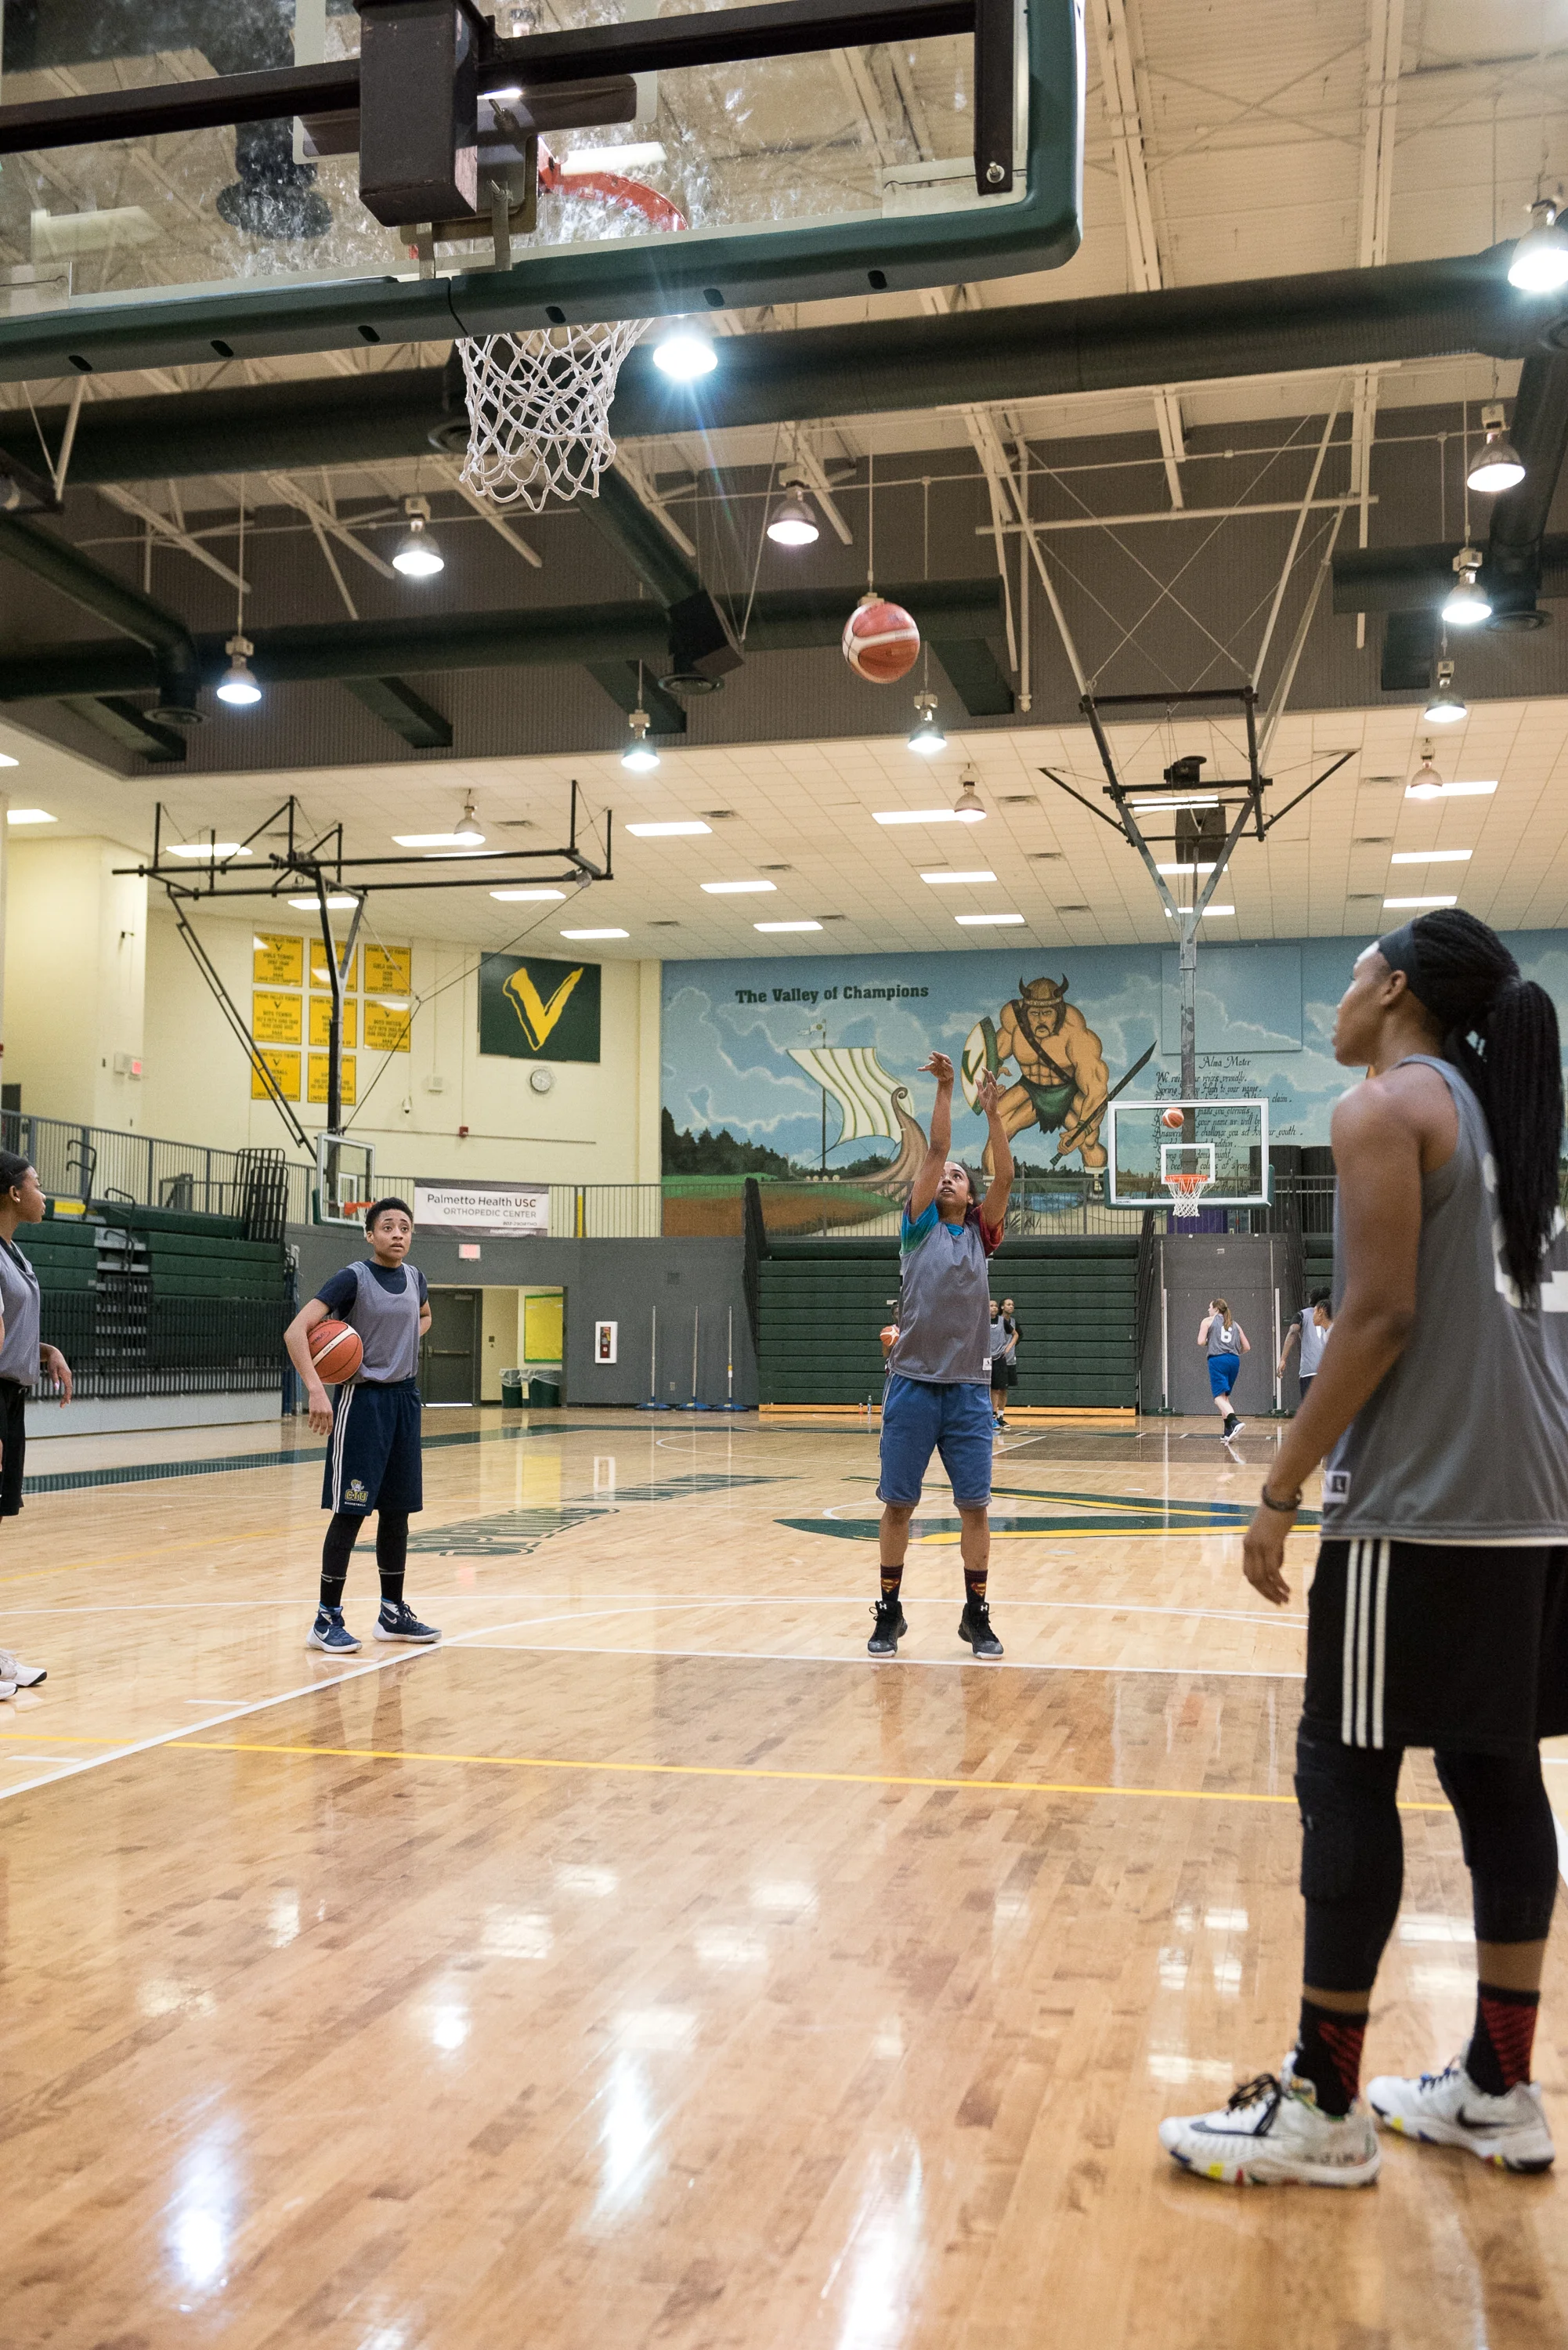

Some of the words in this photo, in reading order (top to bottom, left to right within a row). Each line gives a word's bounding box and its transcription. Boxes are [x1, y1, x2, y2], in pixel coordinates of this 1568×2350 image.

[735, 989, 768, 1003] The
[771, 988, 819, 1004] Valley
[823, 986, 838, 1000] of
[843, 985, 930, 1001] Champions
[1198, 1055, 1223, 1069] Alma
[1223, 1055, 1252, 1068] Mater
[427, 1194, 475, 1206] Palmetto
[479, 1197, 512, 1207] Health
[515, 1198, 537, 1208] USC
[443, 1207, 500, 1217] ORTHOPEDIC
[1220, 1325, 1232, 1343] 6
[345, 1488, 369, 1503] CIU
